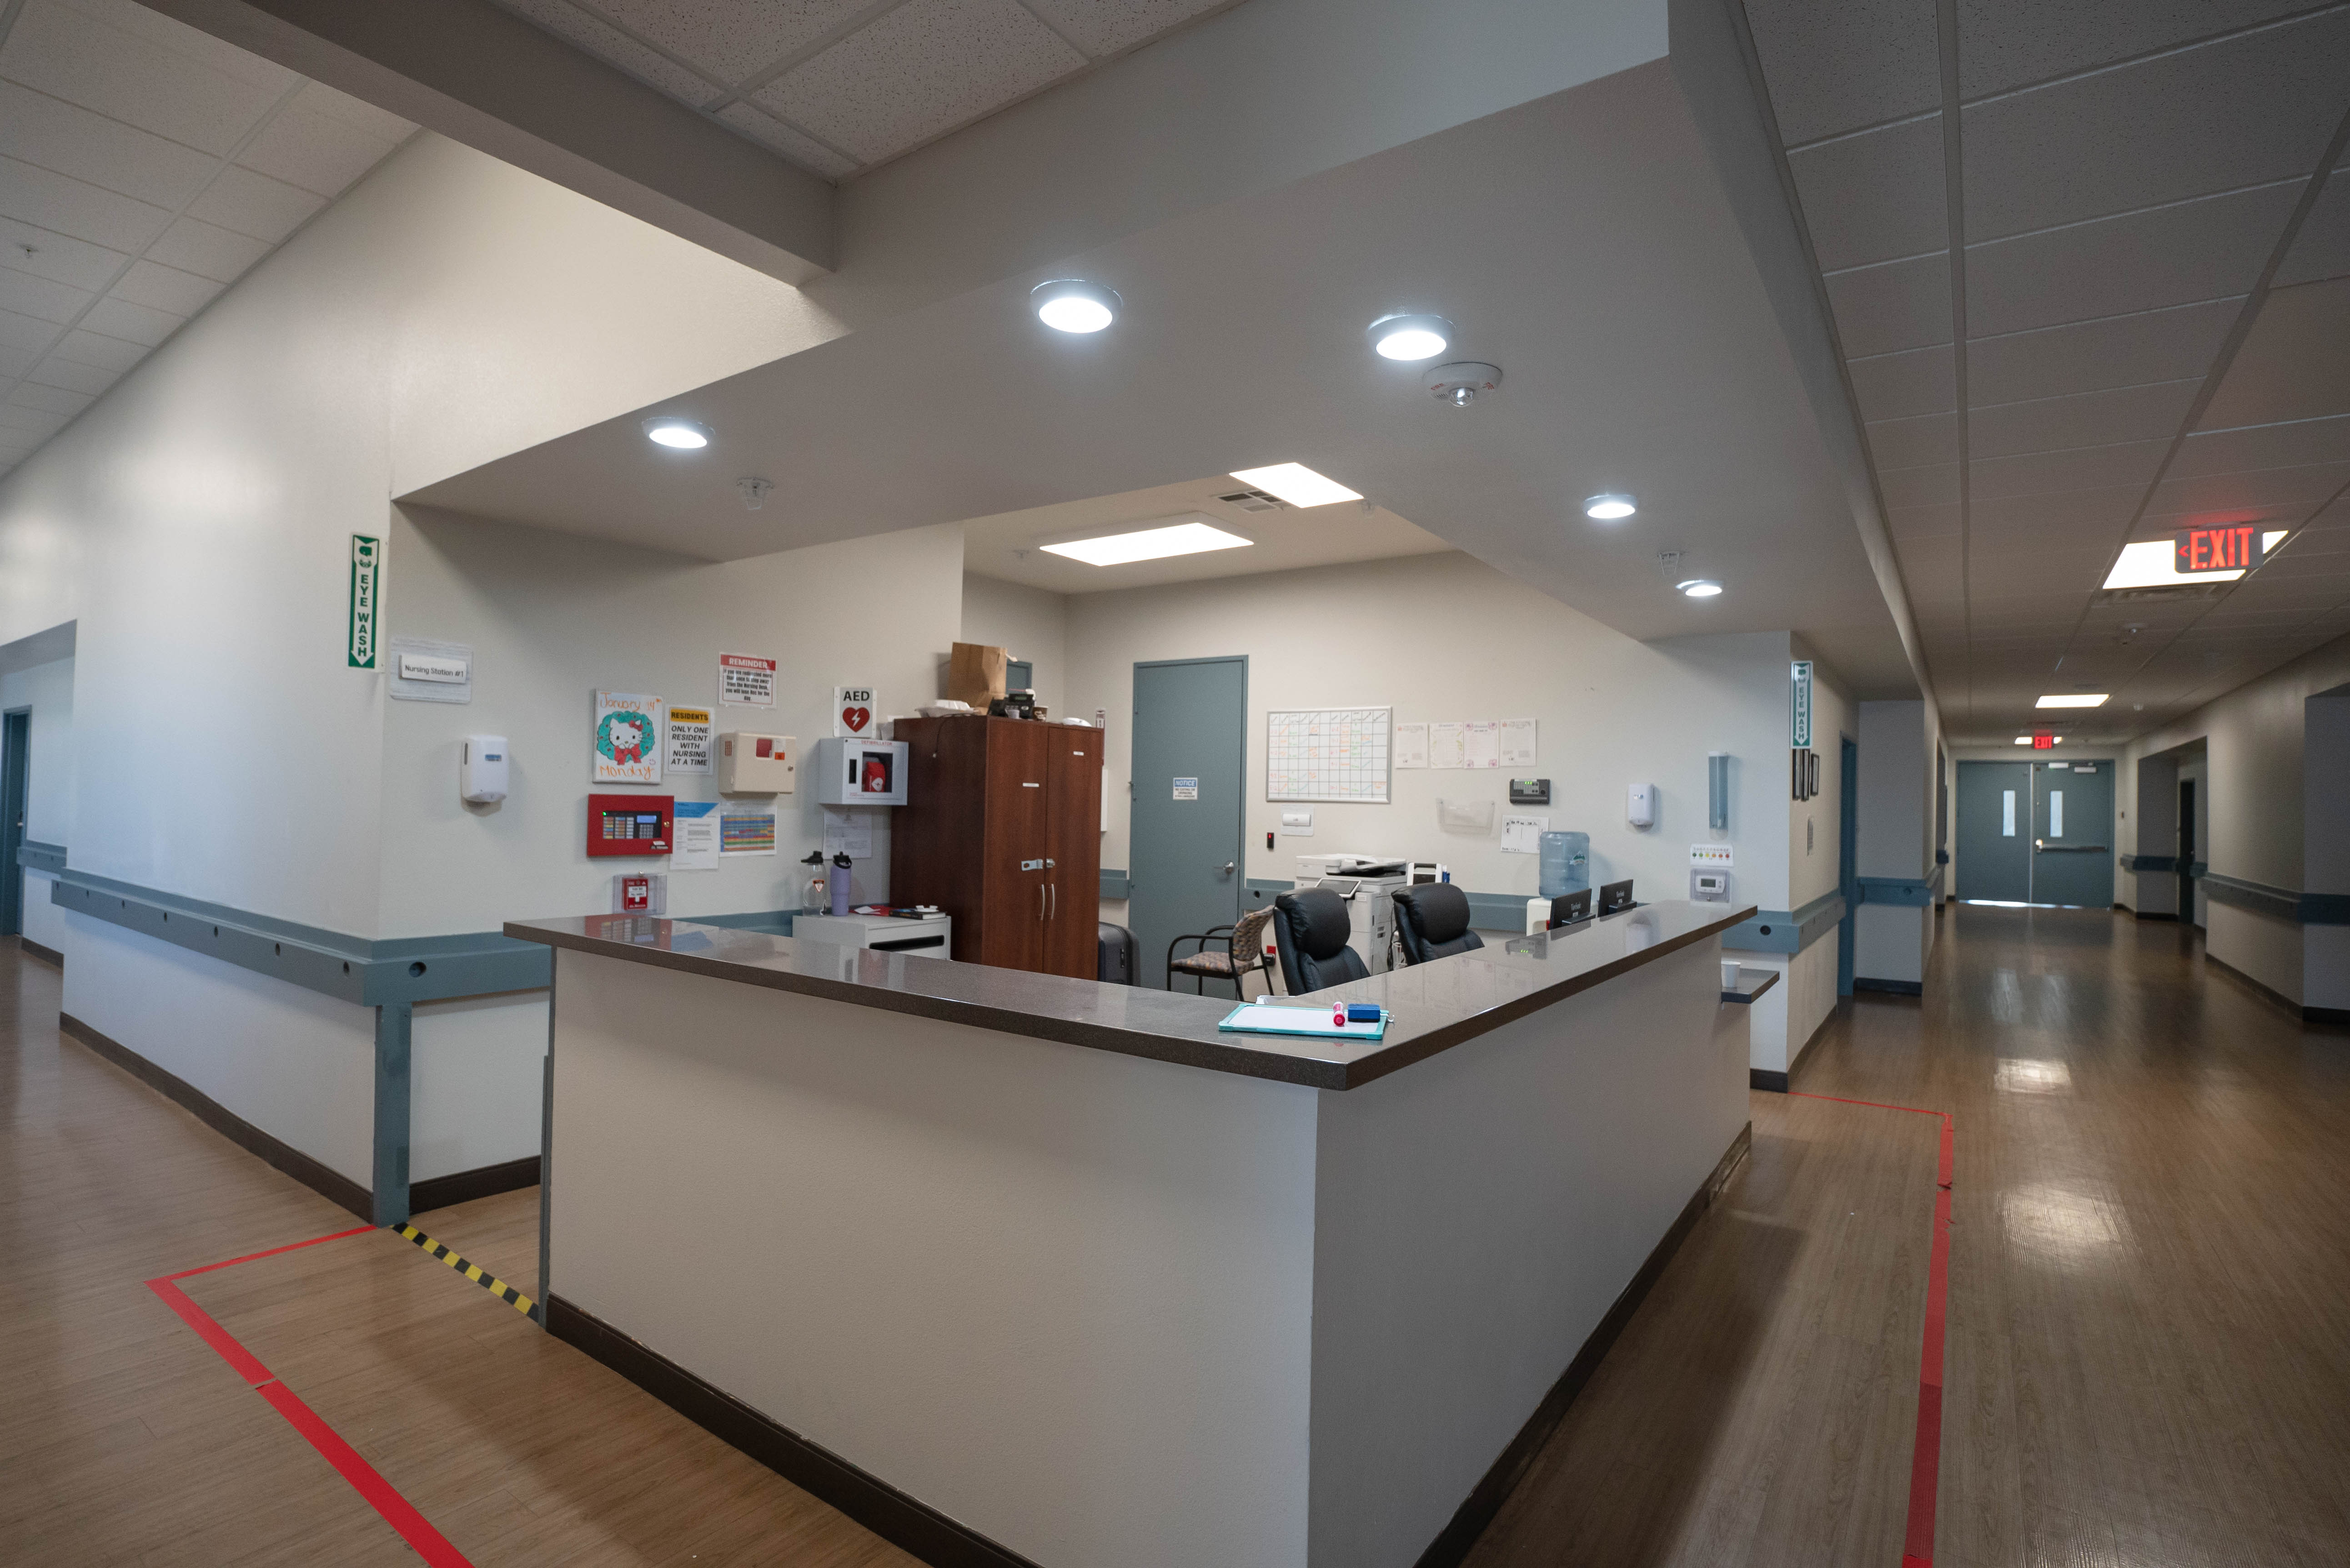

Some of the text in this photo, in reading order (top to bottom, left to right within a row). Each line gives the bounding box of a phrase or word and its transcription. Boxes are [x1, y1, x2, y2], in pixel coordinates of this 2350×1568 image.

[2190, 528, 2253, 569] EXIT
[357, 574, 369, 657] EYE WASH
[405, 664, 429, 674] Nursing
[431, 668, 453, 676] Station
[729, 658, 768, 669] REMINDER
[600, 692, 641, 712] January
[843, 691, 869, 701] AED
[671, 712, 708, 721] RESIDENTS
[1798, 711, 1806, 739] WASH
[672, 734, 708, 742] RESIDENT
[2034, 736, 2053, 749] EXIT
[599, 764, 654, 780] Monday
